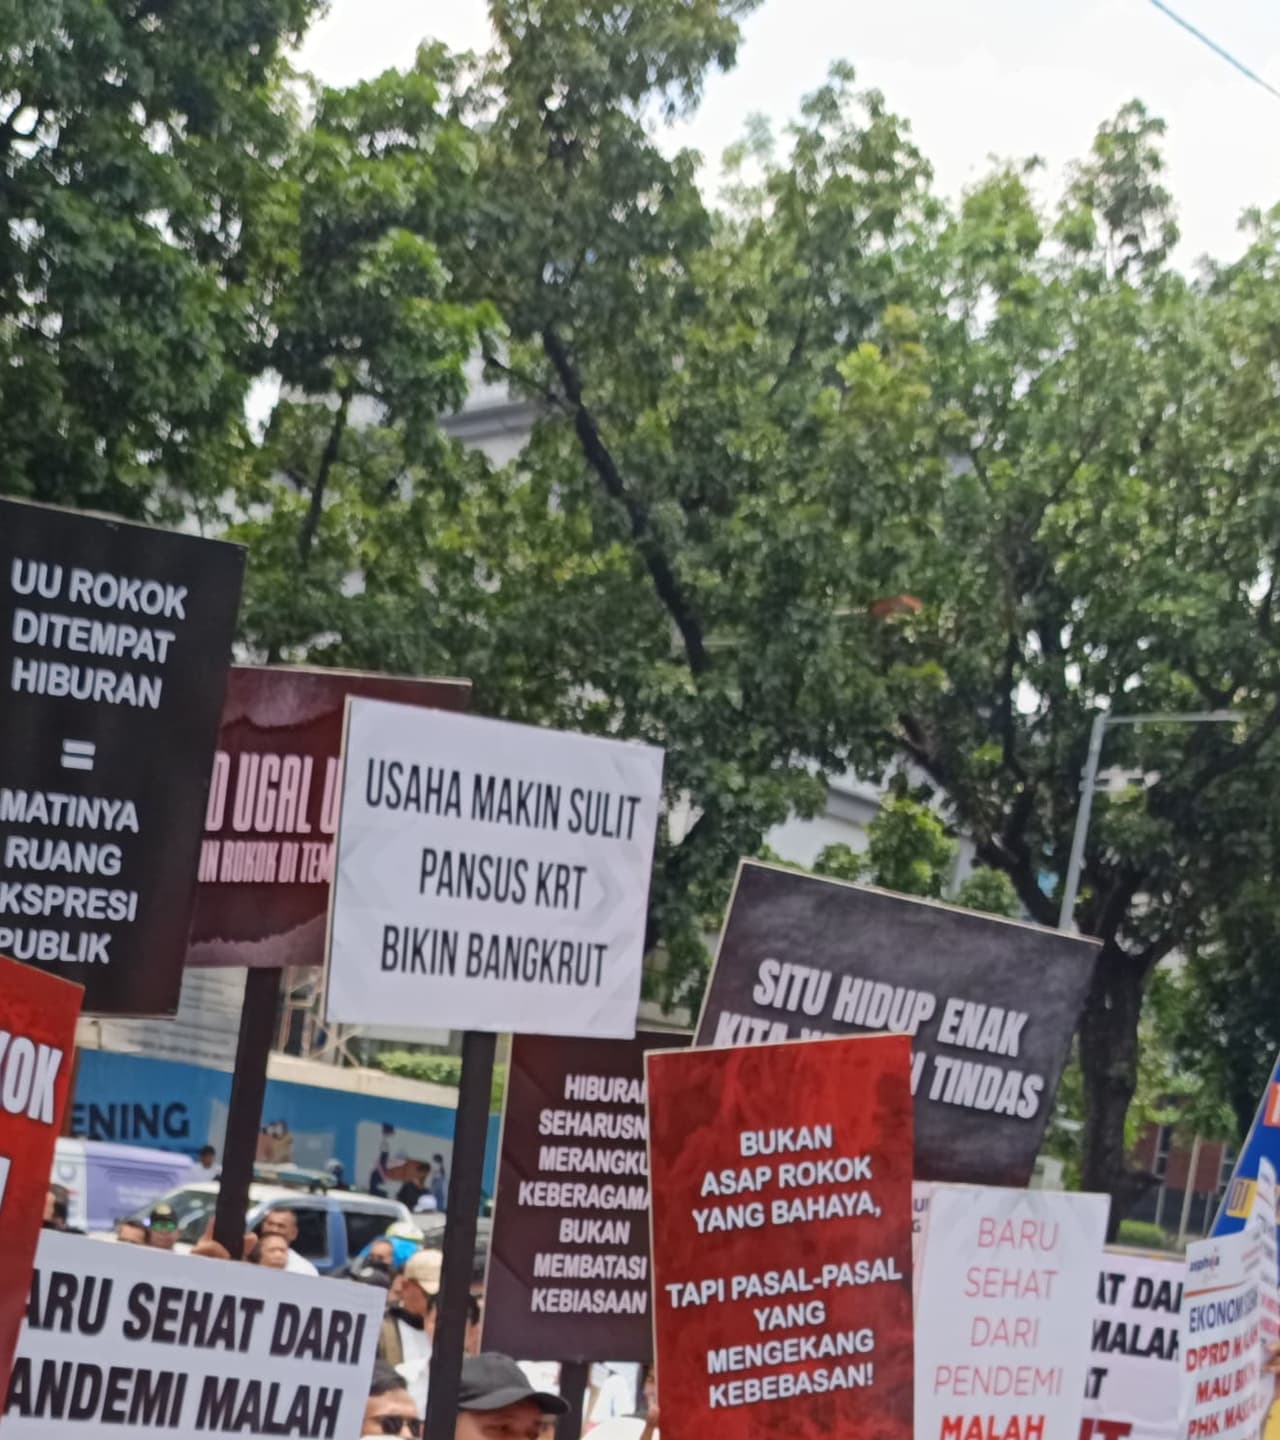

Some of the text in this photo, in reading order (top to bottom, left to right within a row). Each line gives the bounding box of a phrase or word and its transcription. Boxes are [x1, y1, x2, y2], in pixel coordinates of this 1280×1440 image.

[11, 558, 187, 620] UU ROKOK
[11, 608, 175, 664] DITEMPAT
[11, 657, 162, 709] HIBURAN
[0, 788, 139, 833] MATINYA
[232, 751, 313, 833] UGAL
[366, 757, 642, 842] USAHA MAKIN SULIT
[4, 835, 122, 876] RUANG
[220, 840, 280, 883] ROKOK
[277, 841, 300, 883] DI
[418, 847, 588, 912] PANSUS KRT
[380, 925, 608, 989] BIKIN BANGKRUT
[753, 959, 1028, 1057] SITU HIDUP ENAK
[928, 1055, 1044, 1119] TINDAS
[71, 1101, 190, 1140] ENING
[539, 1109, 647, 1140] SEHARUSN
[740, 1124, 832, 1156] BUKAN
[539, 1146, 649, 1176] MERANGKU
[700, 1156, 872, 1197] ASAP ROKOK
[559, 1218, 630, 1245] BUKAN
[692, 1203, 764, 1233] YANG
[772, 1191, 881, 1225] BAHAYA,
[977, 1217, 1059, 1251] BARU
[534, 1253, 647, 1280] MEMBATASI
[665, 1257, 902, 1308] TAPI PASAL-PASAL
[965, 1267, 1058, 1300] SEHAT
[25, 1269, 368, 1365] ARU SEHAT DARI
[531, 1289, 647, 1314] KEBIASAAN
[754, 1301, 825, 1331] YANG
[707, 1329, 874, 1374] MENGEKANG
[970, 1317, 1039, 1348] DARI
[1, 1357, 343, 1440] ANDEMI MALAH
[709, 1363, 873, 1408] KEBEBASAN!
[934, 1366, 1063, 1397] PENDEMI
